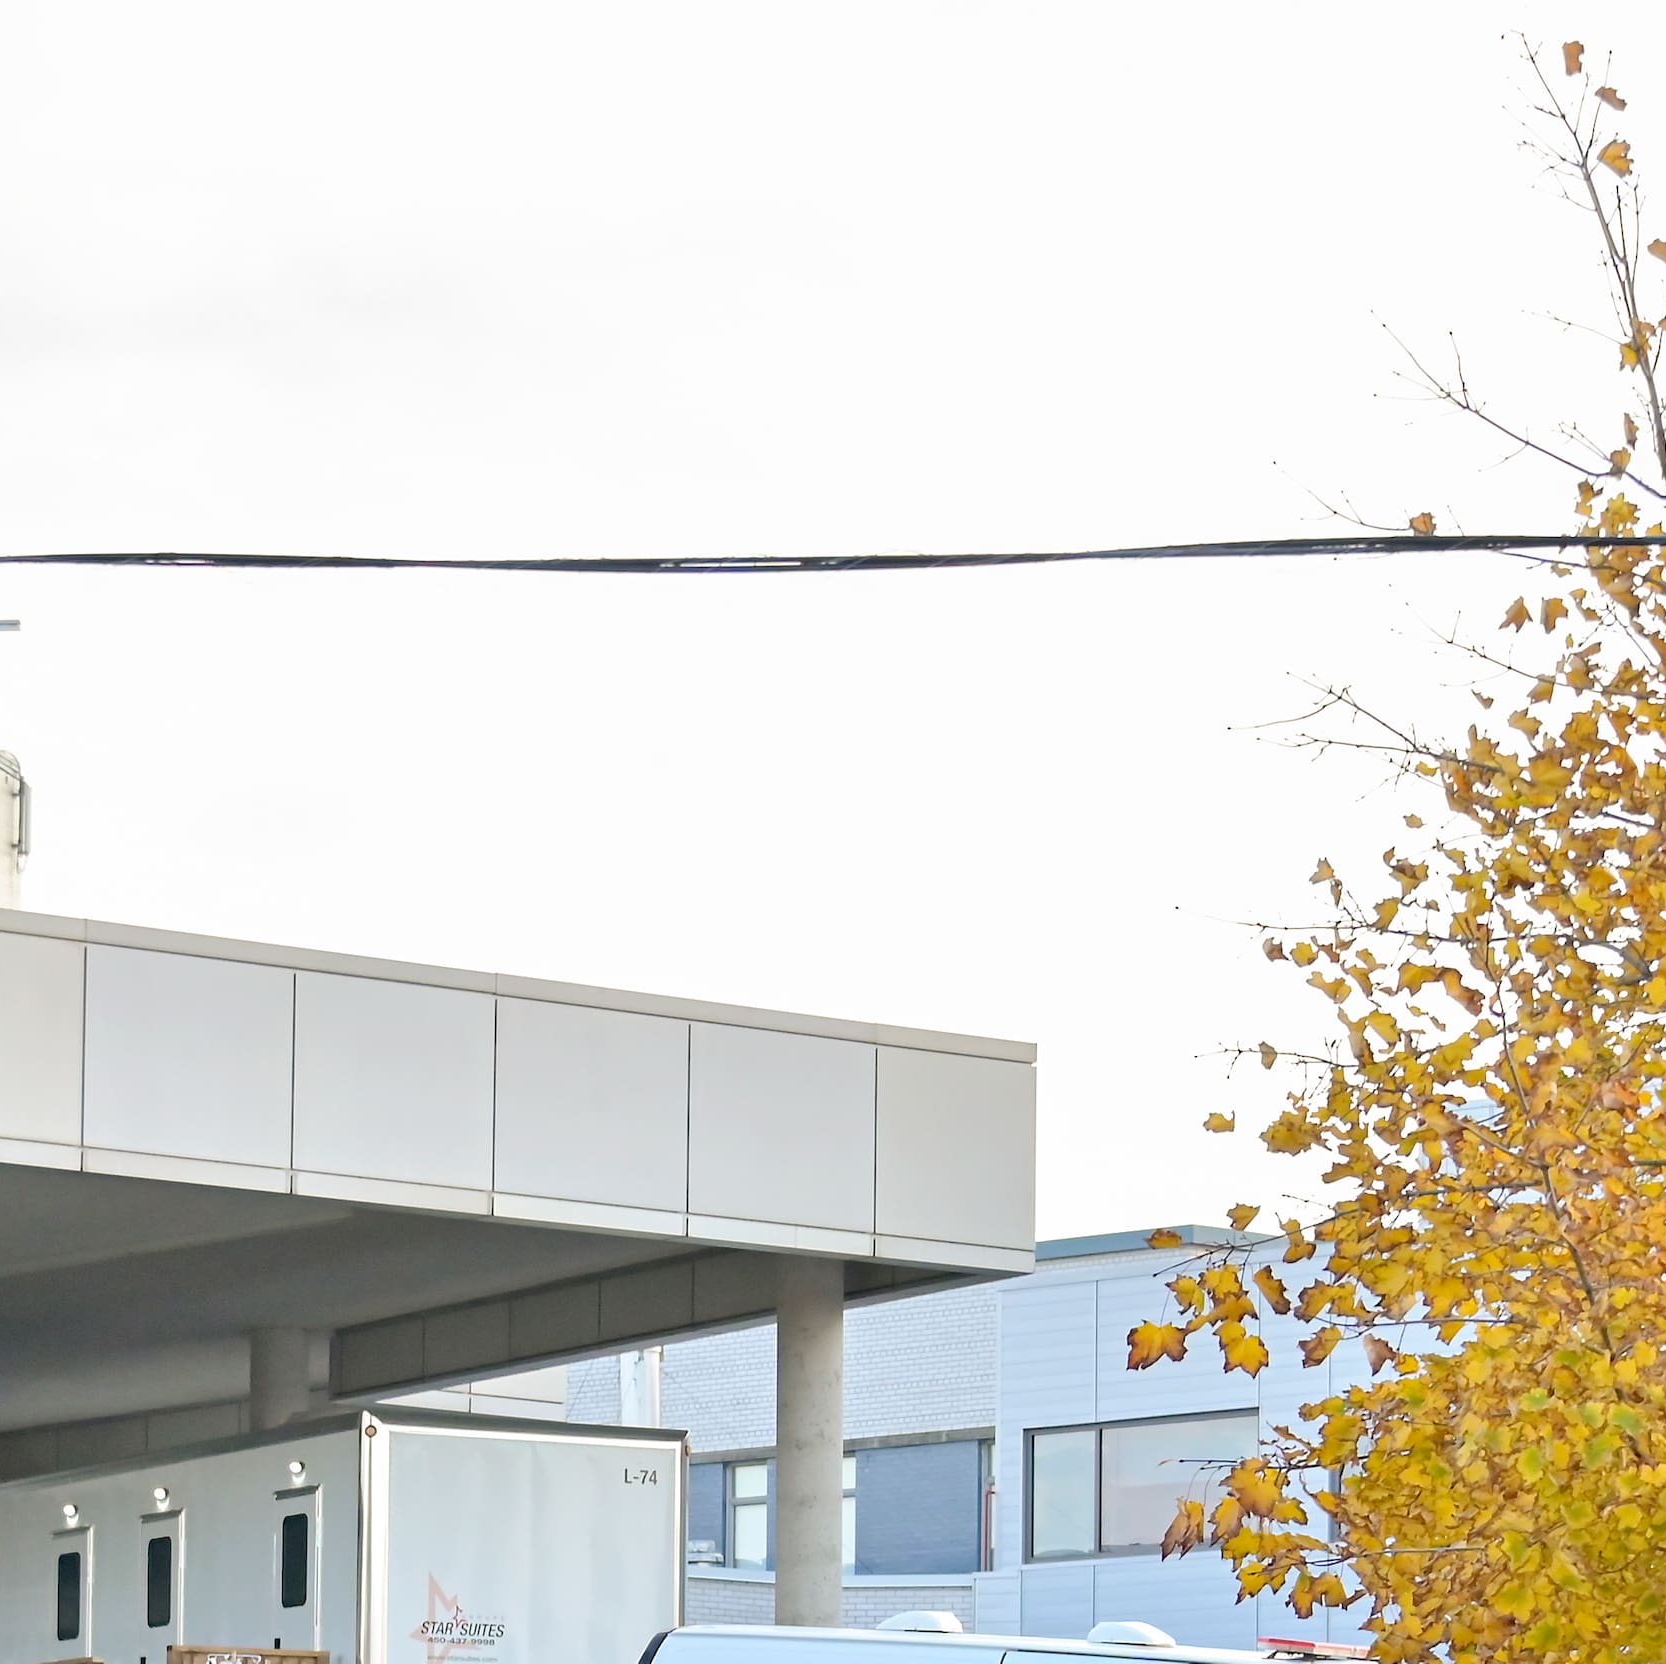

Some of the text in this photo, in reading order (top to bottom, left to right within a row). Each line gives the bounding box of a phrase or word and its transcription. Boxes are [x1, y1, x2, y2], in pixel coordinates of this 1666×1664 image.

[624, 1468, 658, 1486] L-74
[421, 1620, 505, 1638] STAR SUITES
